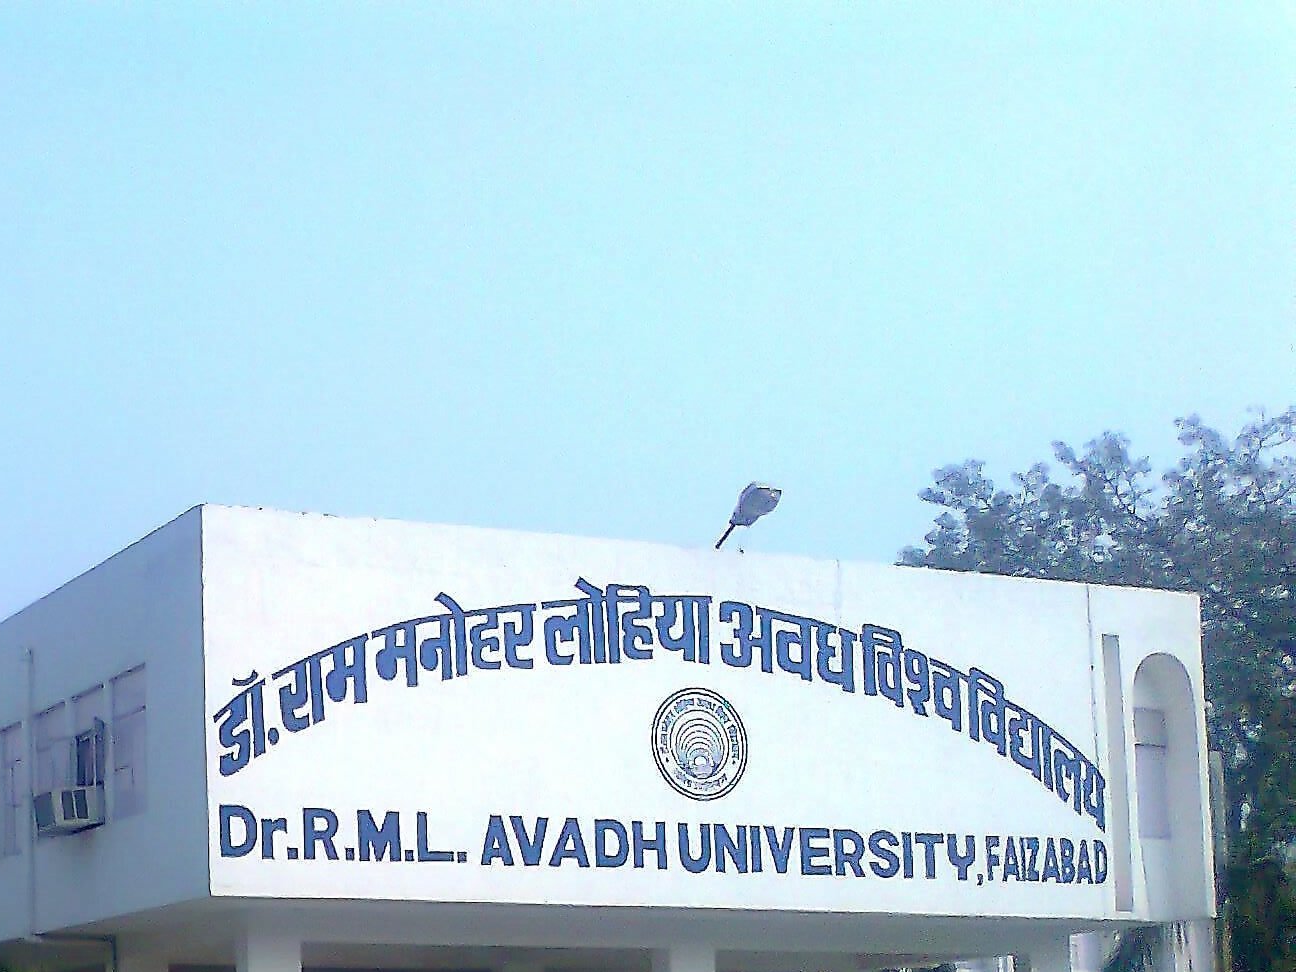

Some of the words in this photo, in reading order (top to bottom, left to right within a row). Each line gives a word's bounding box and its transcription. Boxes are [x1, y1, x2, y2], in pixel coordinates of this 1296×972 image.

[371, 592, 536, 687] मनोहर
[542, 576, 712, 665] लोहिया
[719, 600, 857, 693] अवध
[480, 814, 668, 869] AVADH
[985, 835, 1108, 885] FAIZABAD
